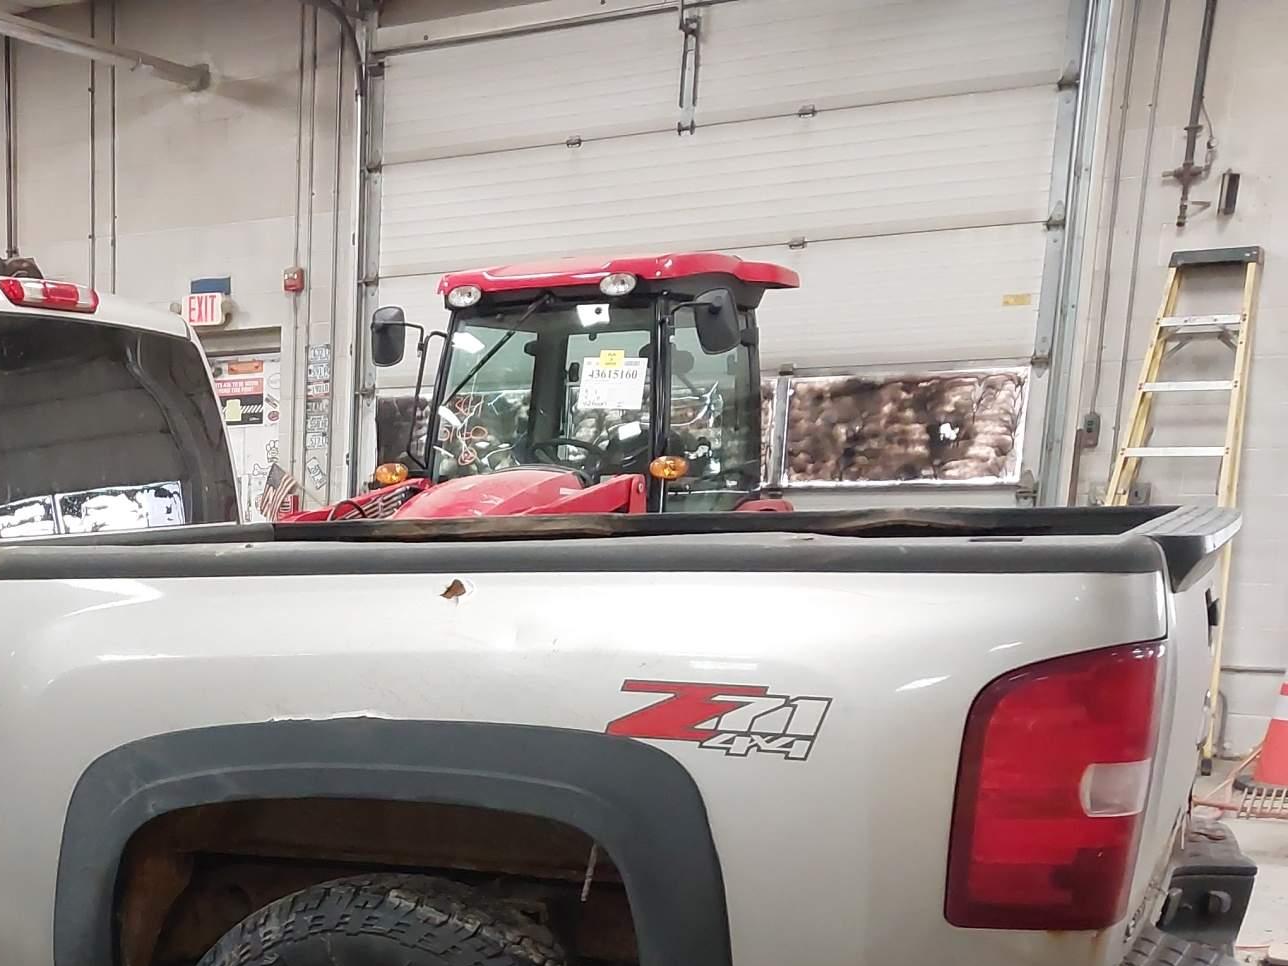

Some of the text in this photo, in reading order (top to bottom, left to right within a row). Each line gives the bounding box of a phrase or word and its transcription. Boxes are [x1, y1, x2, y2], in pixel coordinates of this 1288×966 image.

[188, 295, 217, 323] EXIT
[588, 369, 638, 380] 43615160
[605, 680, 833, 741] Z71
